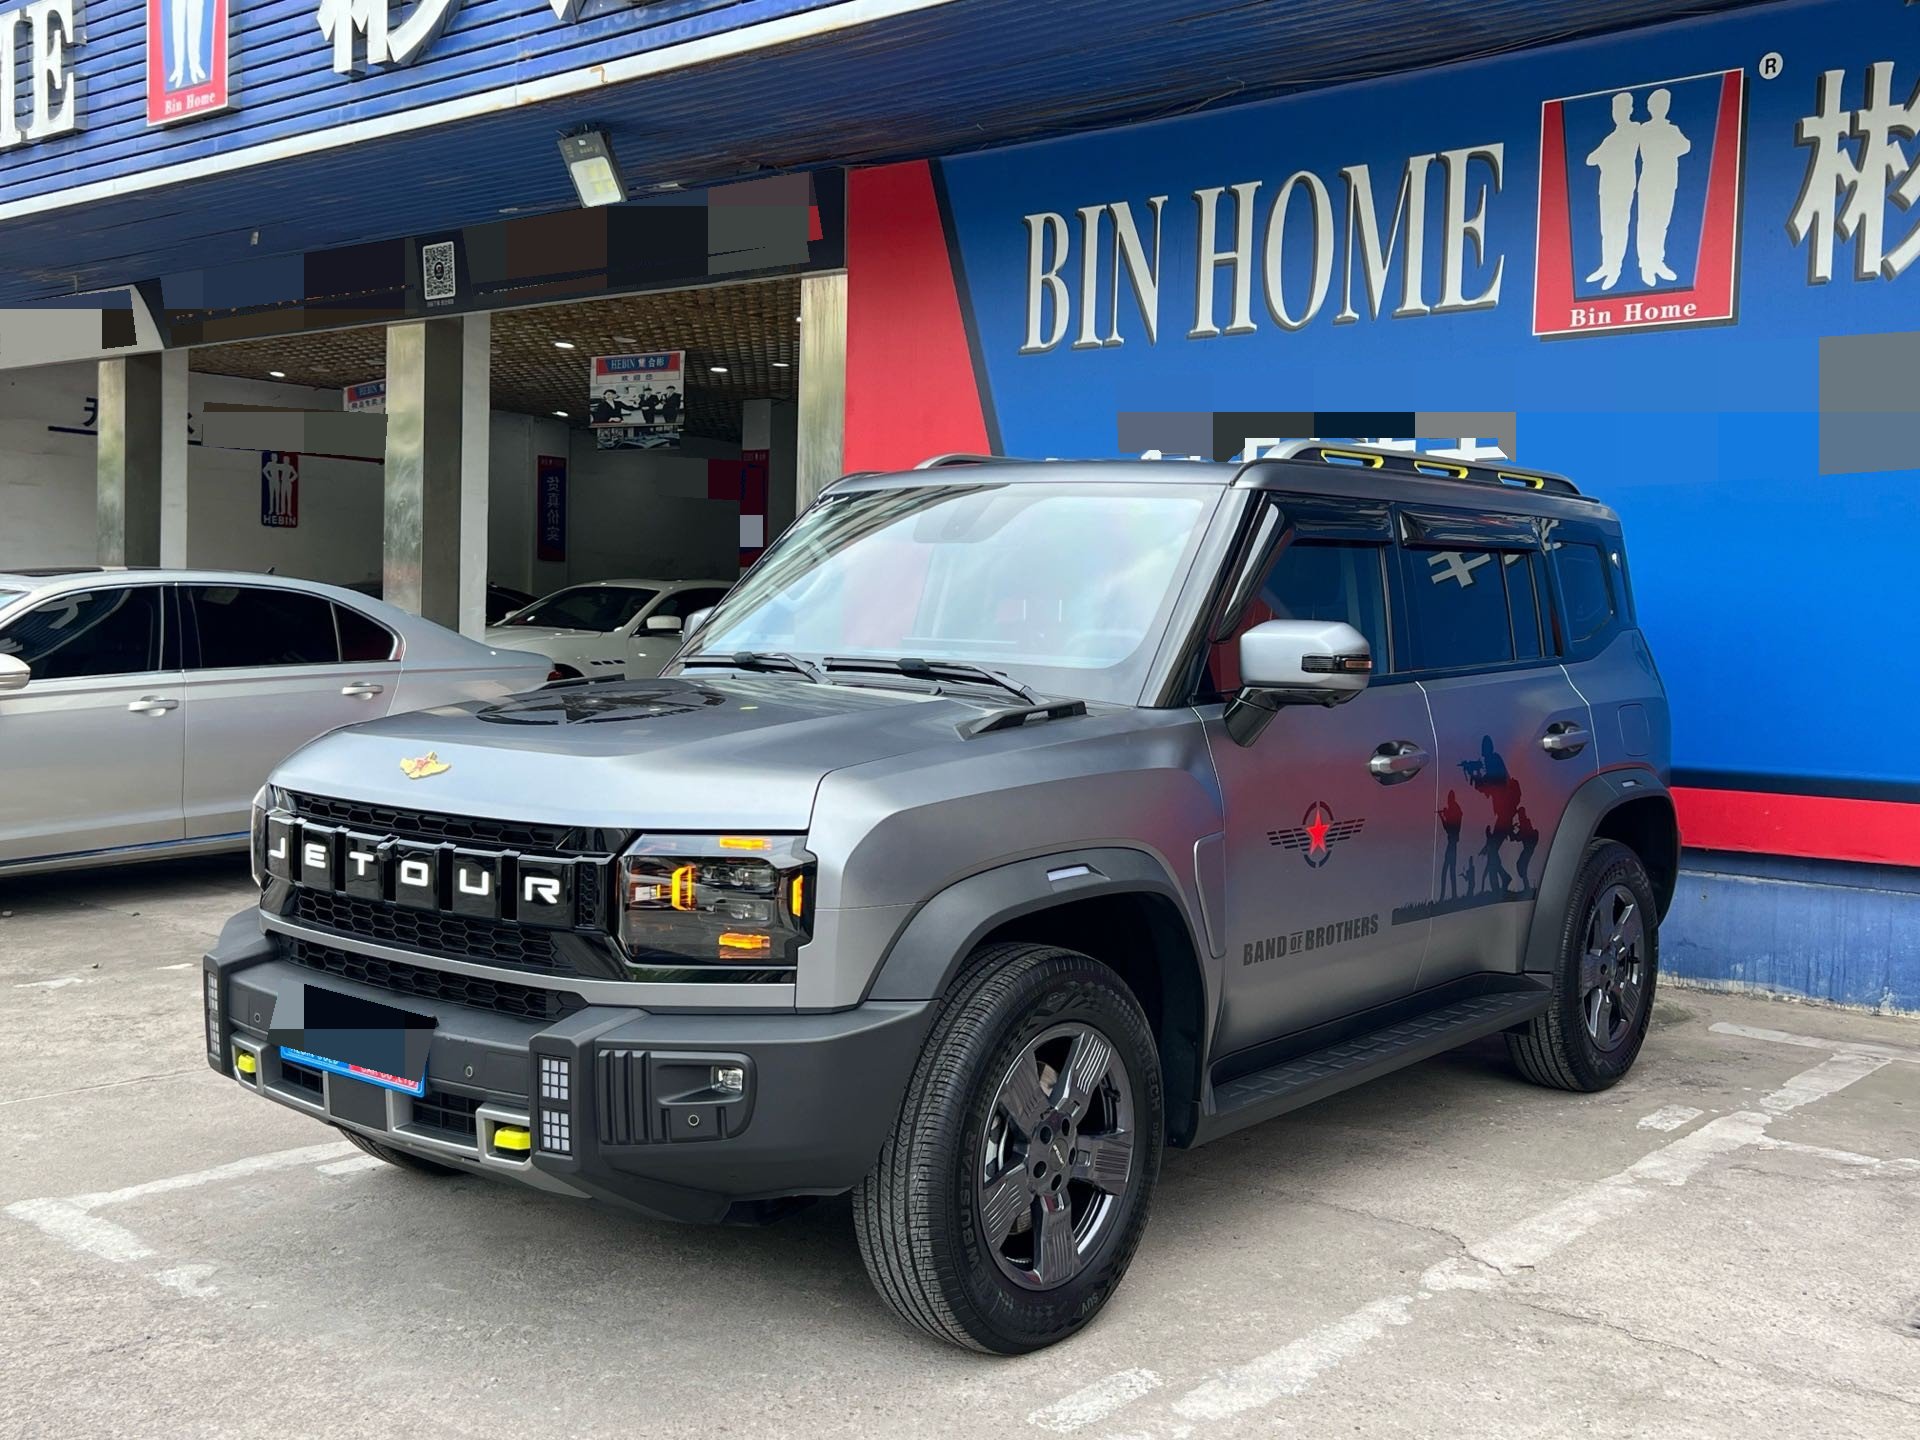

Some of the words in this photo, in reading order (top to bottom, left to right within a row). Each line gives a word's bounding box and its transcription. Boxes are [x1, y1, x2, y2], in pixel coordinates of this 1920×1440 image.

[0, 0, 75, 148] E
[164, 98, 182, 115] Bin
[186, 92, 216, 109] Home
[1020, 195, 1168, 354] BIN
[1188, 142, 1504, 339] HOME
[1569, 307, 1612, 327] Bin
[1623, 302, 1697, 322] Home
[611, 358, 636, 370] HEBIN
[263, 514, 297, 526] HEBIN
[269, 837, 560, 904] JETOUR
[1243, 936, 1288, 966] BAND
[1290, 934, 1304, 952] OF
[1304, 914, 1379, 951] BROTHERS
